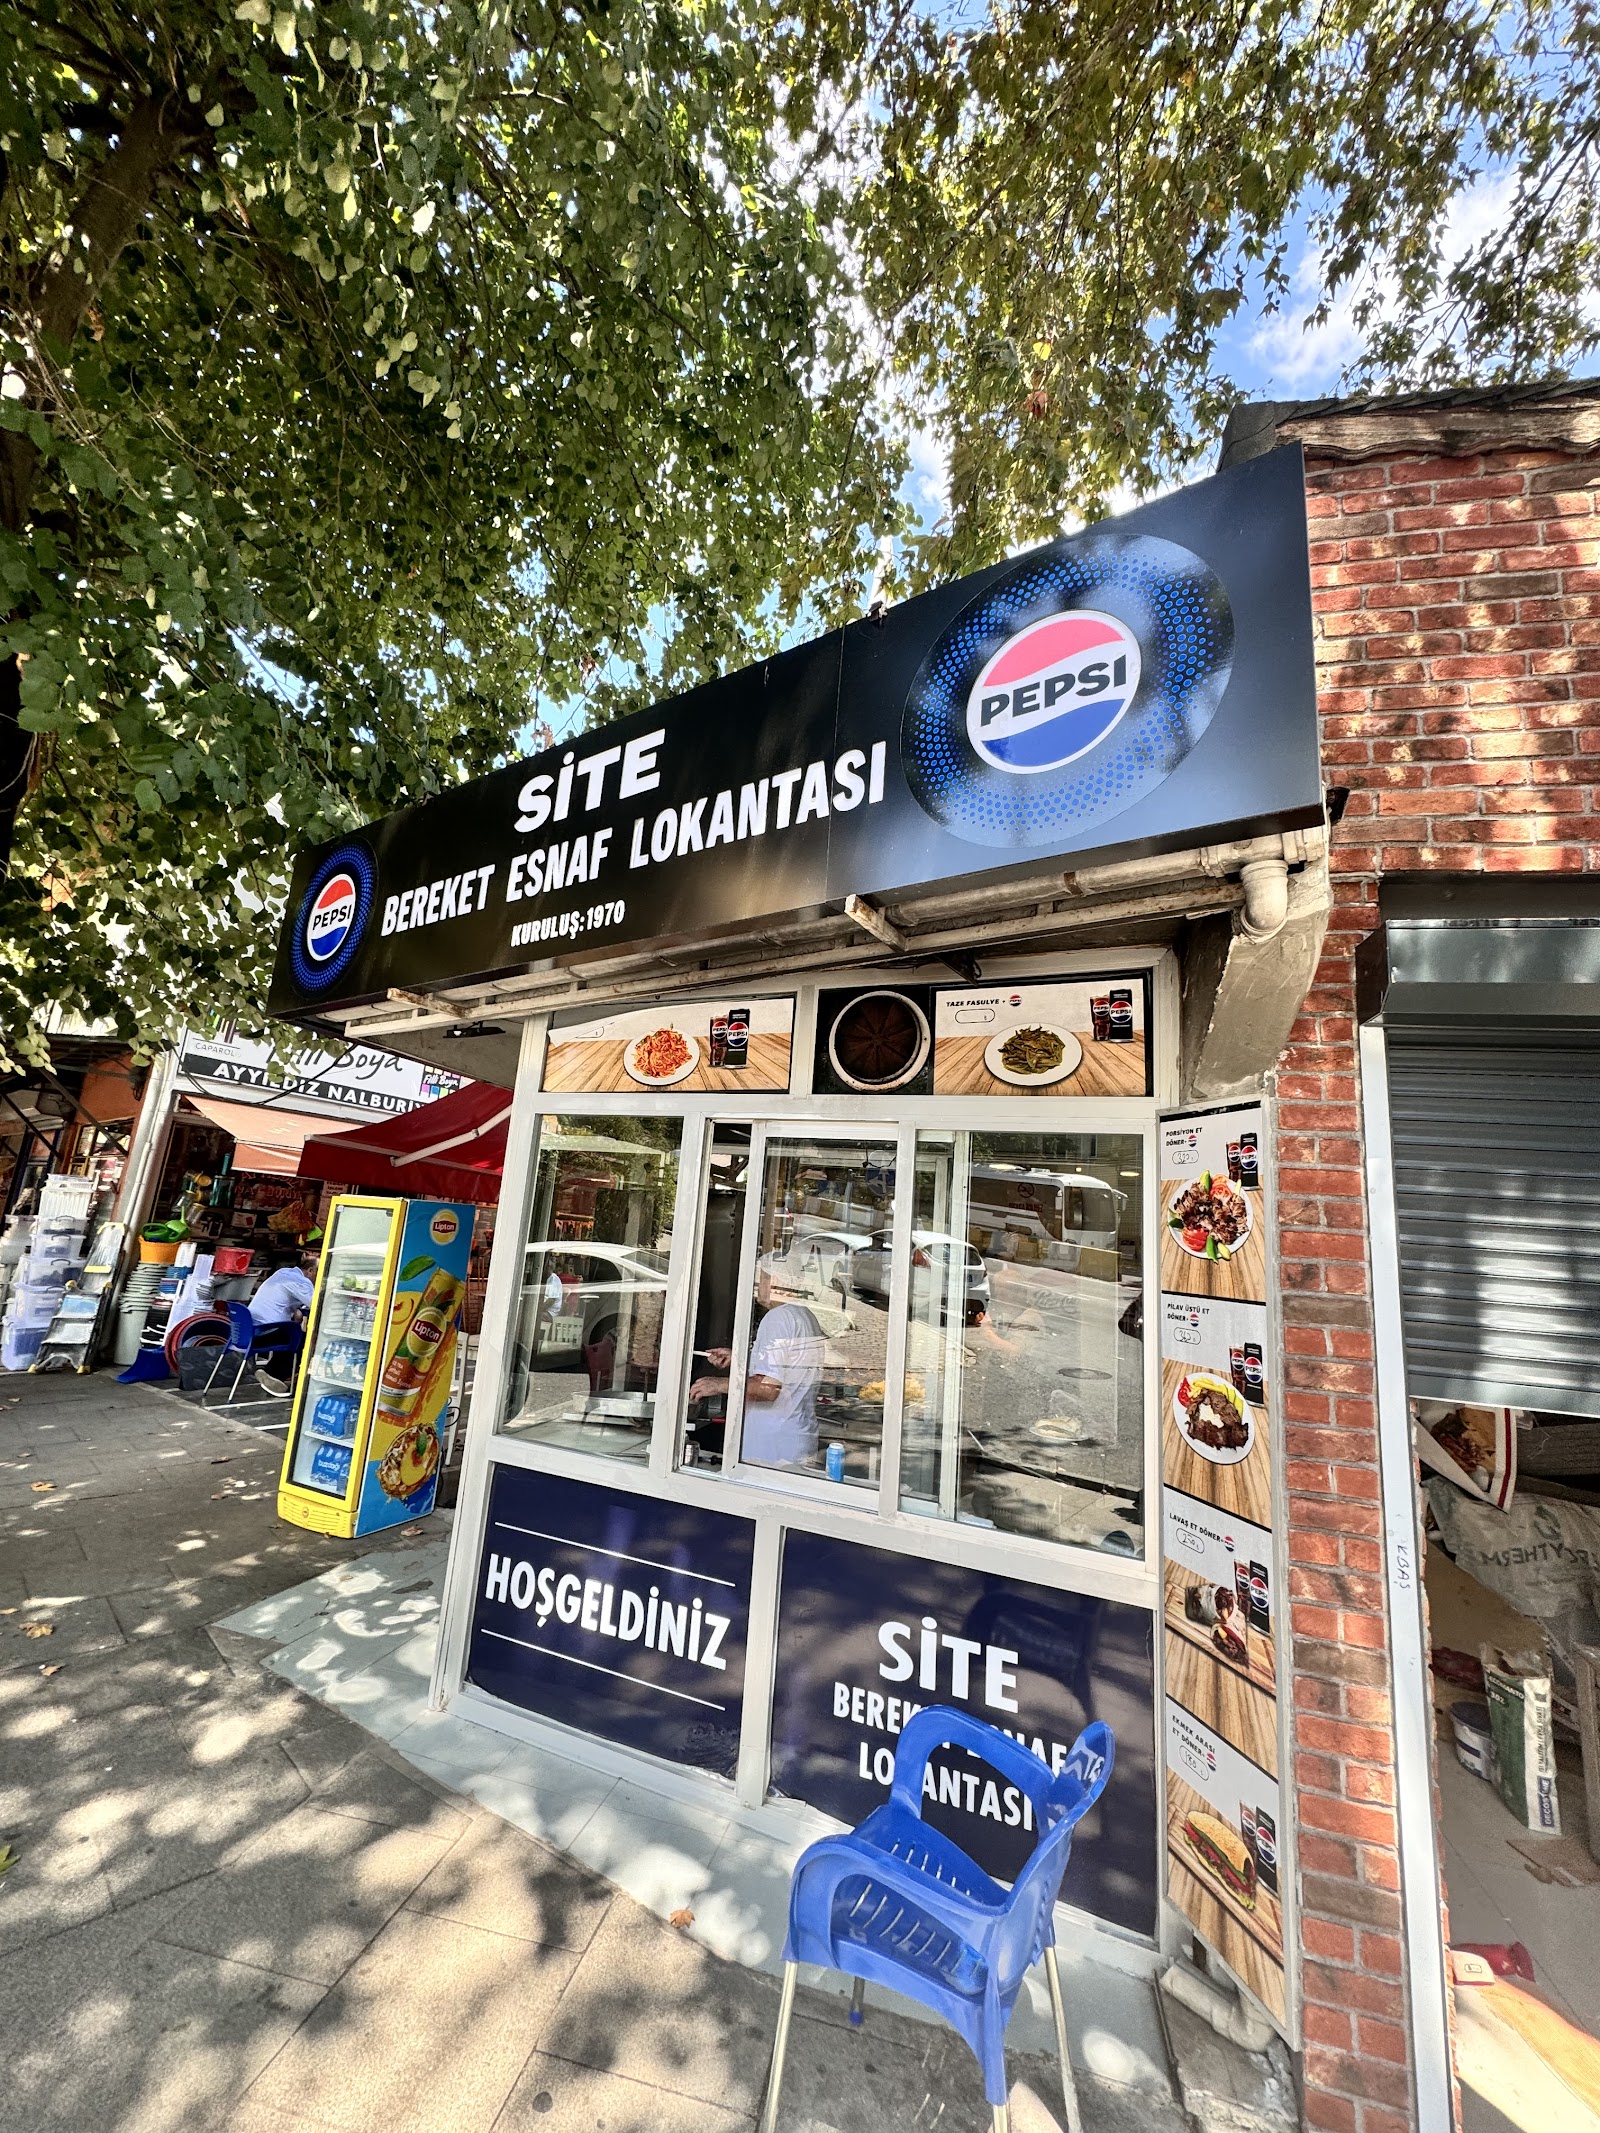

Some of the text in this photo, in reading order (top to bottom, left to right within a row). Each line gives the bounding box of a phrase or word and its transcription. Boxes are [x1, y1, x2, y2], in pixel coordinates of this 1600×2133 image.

[980, 654, 1127, 728] PEPSI
[514, 728, 666, 833] SİTE
[380, 740, 887, 937] BEREKET ESNAF LOKANTASI
[312, 904, 353, 931] PEPSI
[195, 1042, 235, 1057] CAPAROL
[434, 1222, 455, 1232] Lipton
[414, 1321, 440, 1341] Lipton
[1169, 1512, 1188, 1528] LAVAŞ
[1190, 1523, 1198, 1531] ET
[485, 1553, 731, 1671] HOŞGELDİNİZ
[878, 1616, 1019, 1713] SİTE
[1172, 1714, 1194, 1737] EKMEK
[1172, 1726, 1180, 1737] ET
[859, 1741, 1033, 1832] LOANTASI
